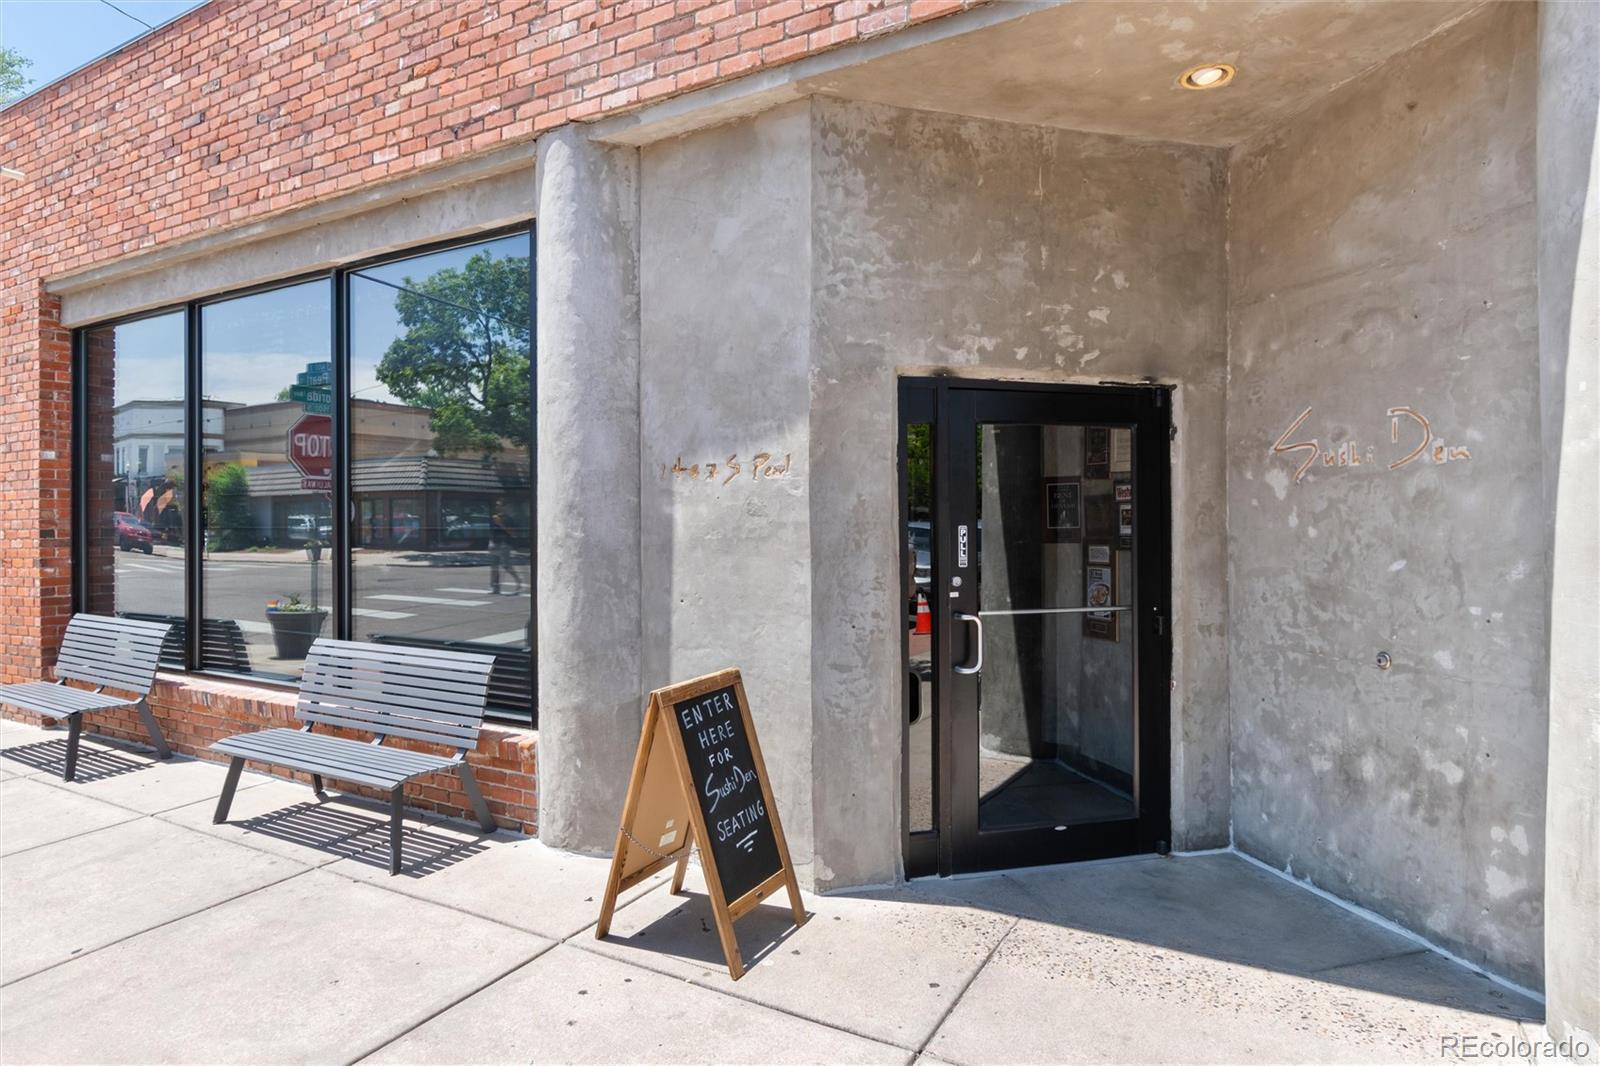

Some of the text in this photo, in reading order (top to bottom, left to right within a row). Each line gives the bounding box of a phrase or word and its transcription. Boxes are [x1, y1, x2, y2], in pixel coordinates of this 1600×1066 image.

[1269, 406, 1472, 484] Sushi Den
[722, 453, 741, 486] S
[959, 529, 967, 557] PULL
[681, 692, 734, 730] ENTER
[698, 720, 735, 750] HERE
[708, 747, 733, 767] FOR
[716, 800, 765, 842] SEATING
